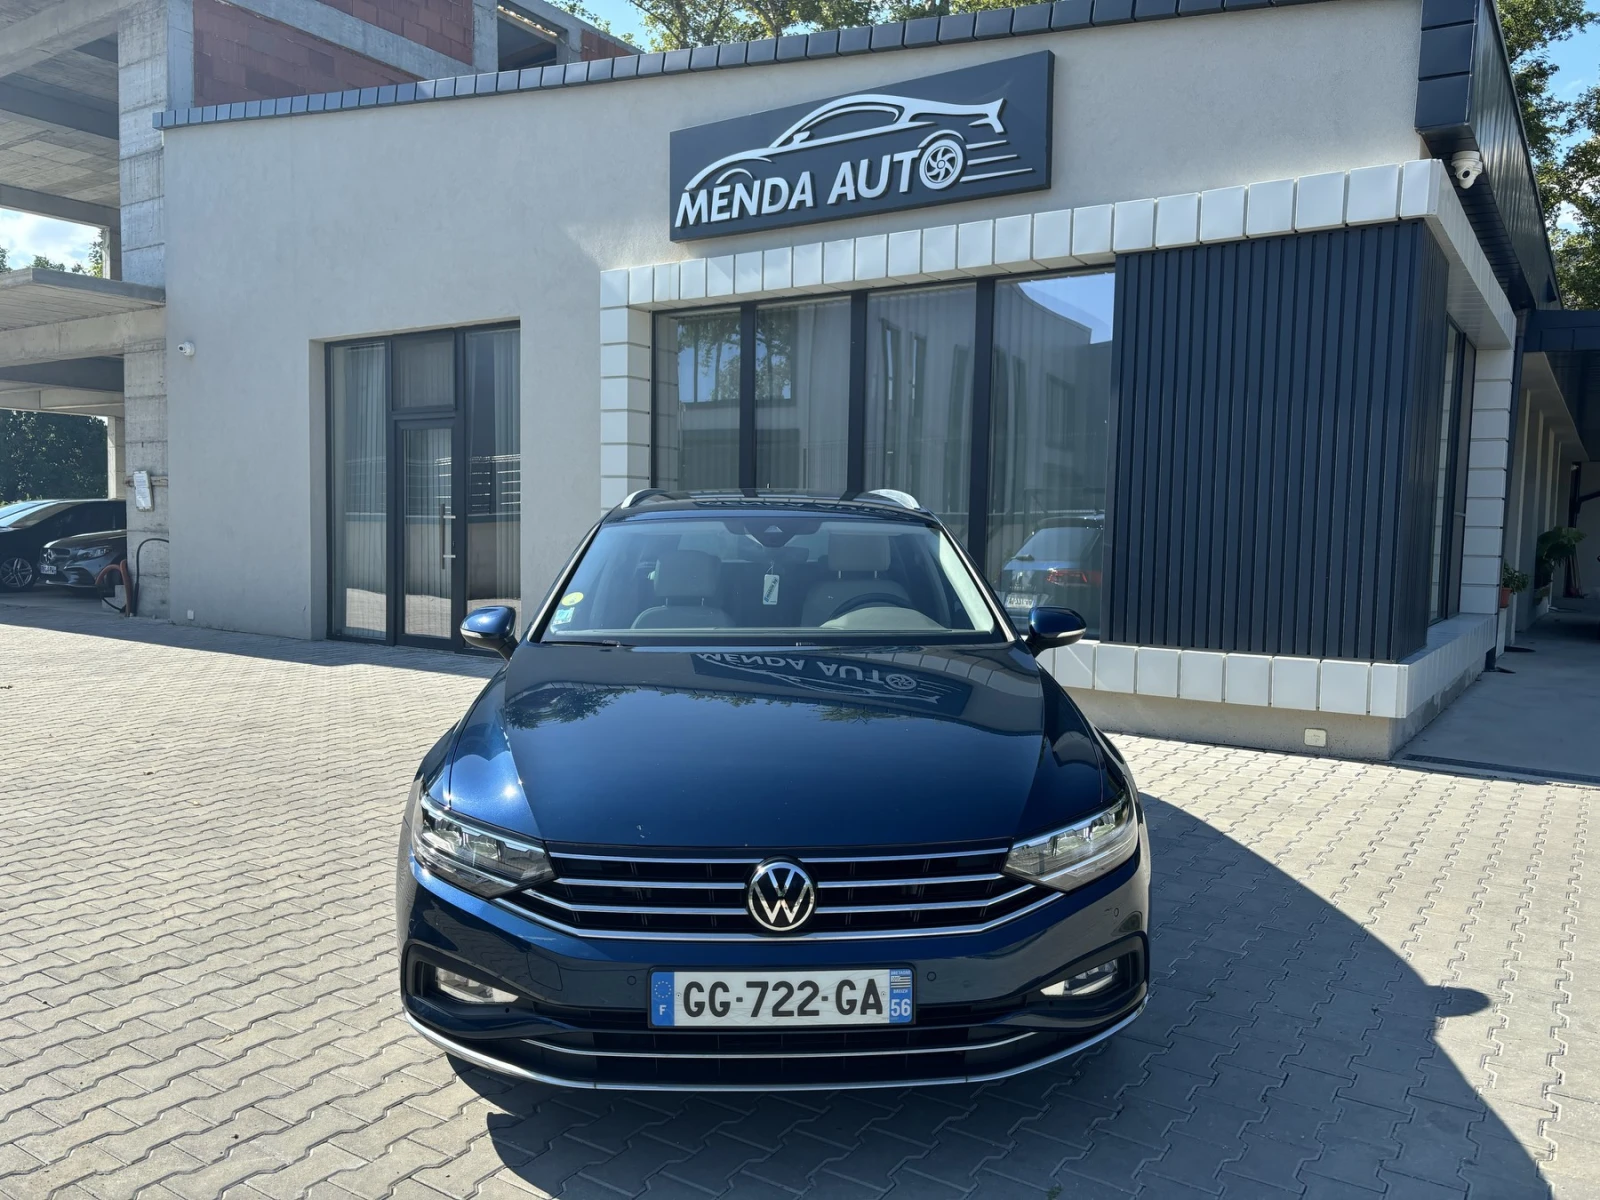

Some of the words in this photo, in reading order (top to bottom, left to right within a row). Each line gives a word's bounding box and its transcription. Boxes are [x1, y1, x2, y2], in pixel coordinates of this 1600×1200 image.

[674, 171, 814, 228] MENDA
[827, 138, 966, 205] AUTO
[659, 1004, 667, 1016] F
[683, 978, 883, 1018] GG-722-GA
[891, 998, 911, 1017] 56
